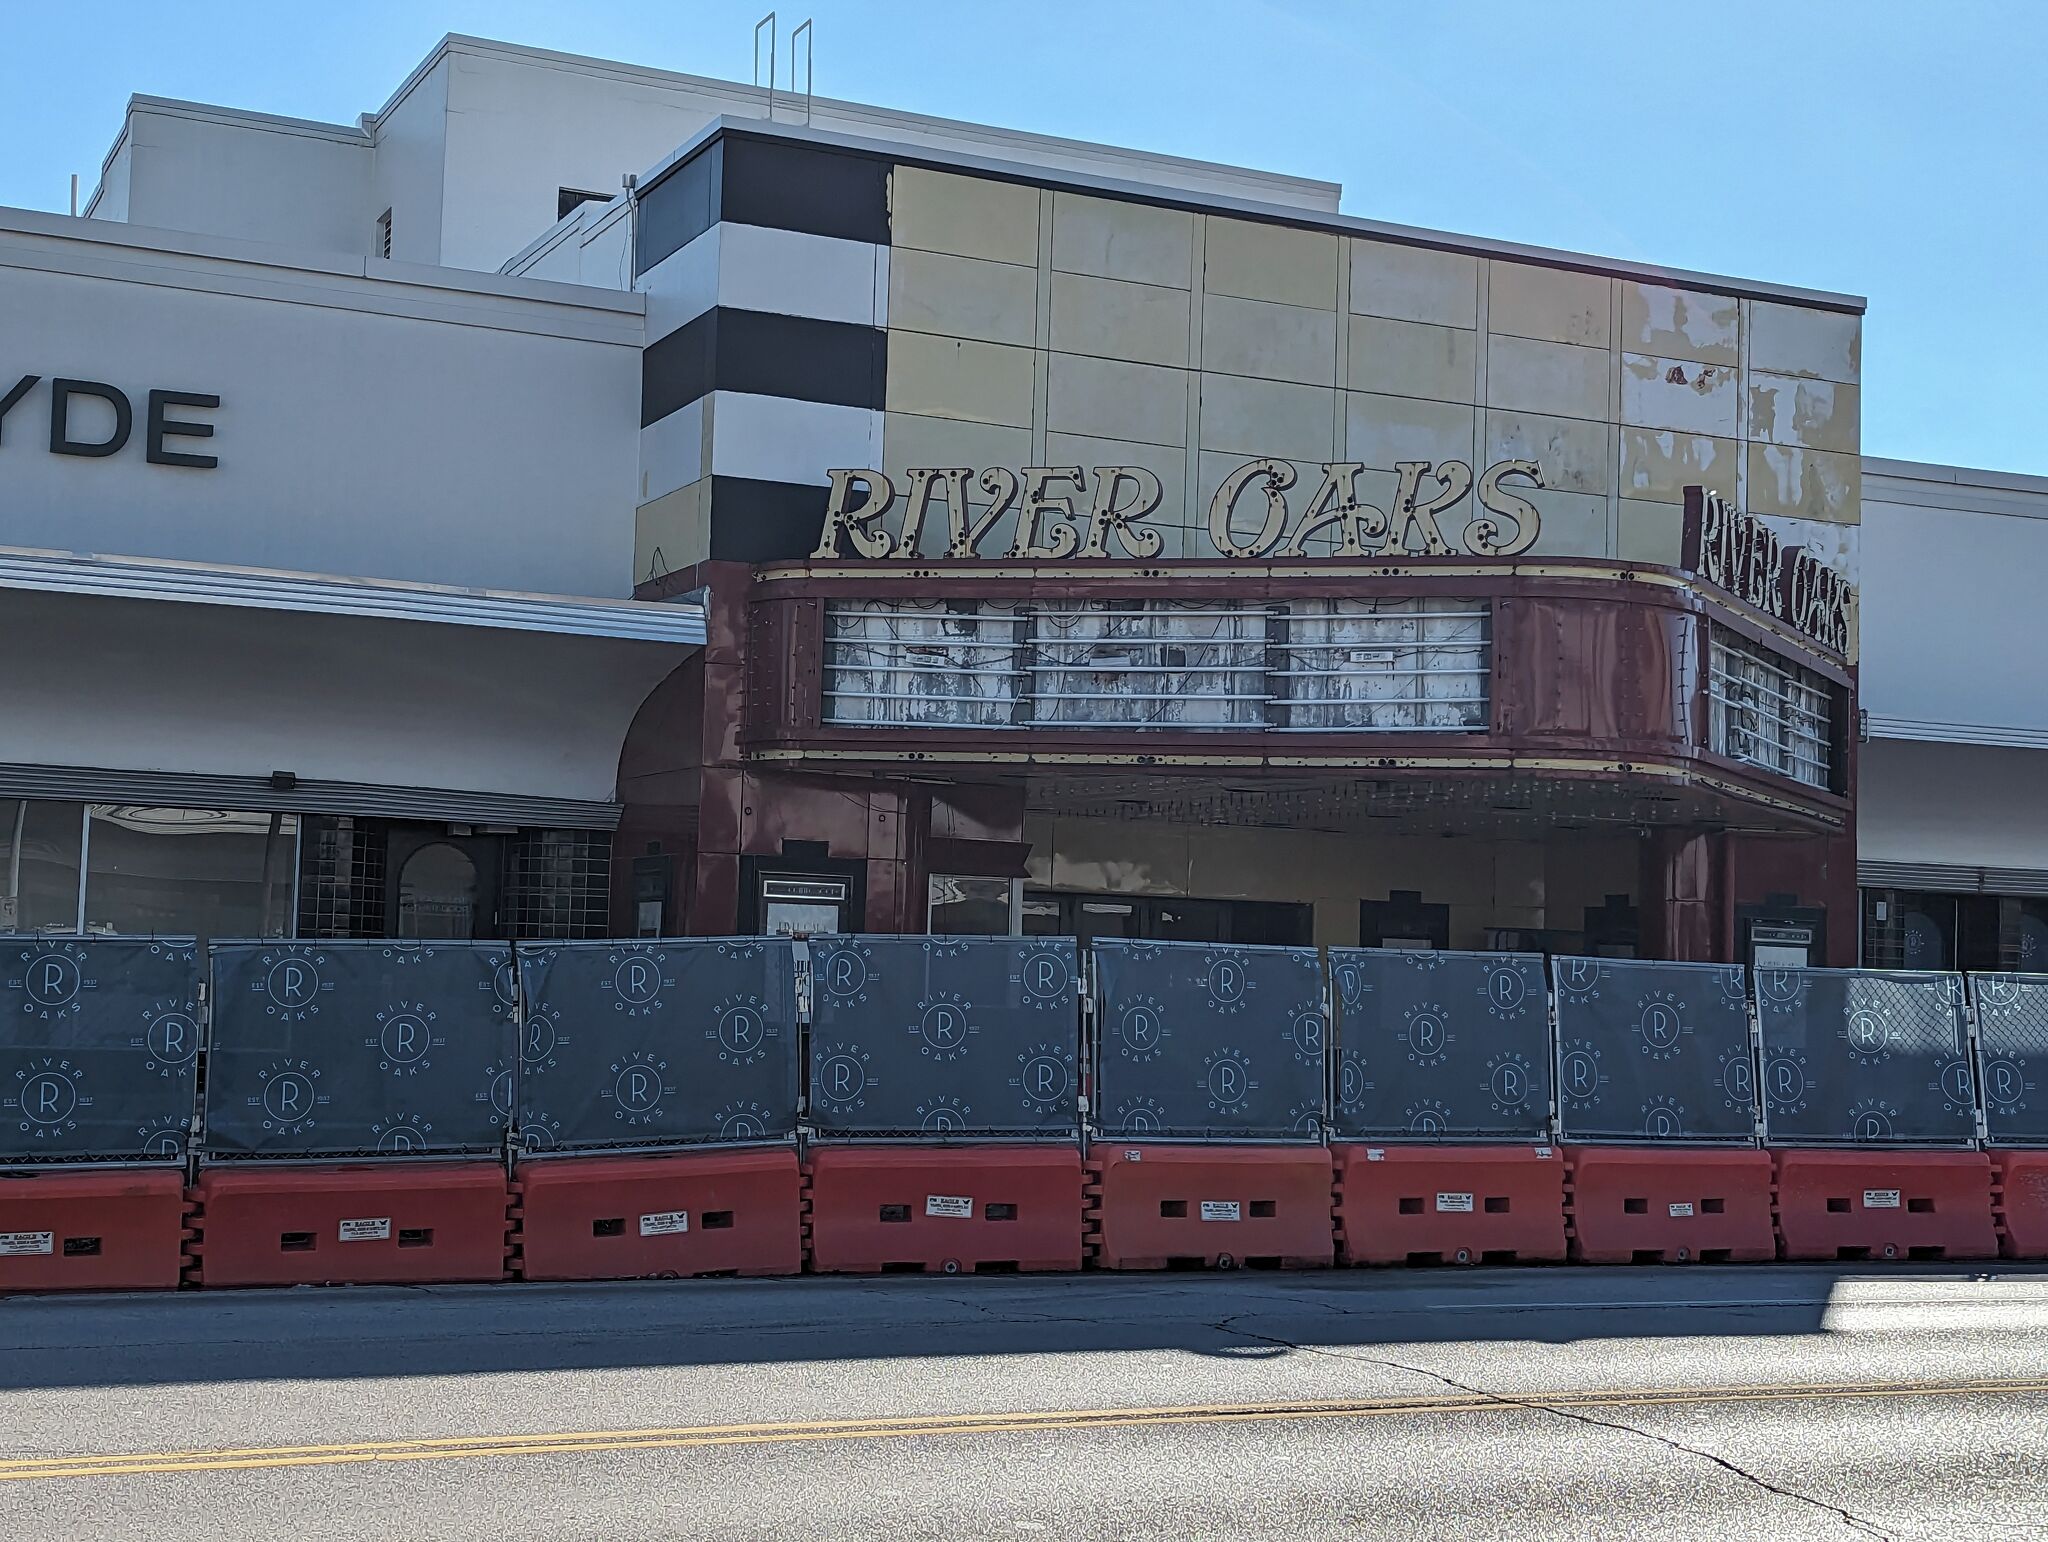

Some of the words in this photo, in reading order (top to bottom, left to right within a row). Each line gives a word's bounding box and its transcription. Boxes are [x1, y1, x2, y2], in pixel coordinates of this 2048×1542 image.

[809, 465, 1165, 559] RIVER
[1207, 459, 1546, 558] OAKS
[1697, 486, 1784, 618] RIVER
[1791, 547, 1852, 657] OAKS
[21, 941, 87, 962] RIVER
[151, 945, 197, 961] OAK
[262, 944, 325, 966] RIVER
[383, 948, 434, 964] OAKS
[609, 944, 666, 964] RIVER
[718, 943, 764, 959] OAKS
[818, 939, 872, 959] RIVER
[922, 942, 969, 958] OAKS
[1018, 941, 1072, 959] RIVER
[1123, 947, 1162, 961] OAKS
[1204, 947, 1250, 967] RIVER
[837, 958, 852, 986] R
[1406, 957, 1446, 970] OAKS
[1483, 956, 1528, 974] RIVER
[44, 963, 63, 994] R
[285, 967, 303, 997] R
[631, 965, 647, 994] R
[1038, 961, 1054, 989] R
[1221, 966, 1234, 993] R
[1343, 970, 1355, 995] R
[1500, 975, 1512, 1000] R
[1559, 989, 1600, 1004] OAKS
[615, 1000, 662, 1016] OAKS
[713, 994, 769, 1014] RIVER
[822, 993, 867, 1008] OAKS
[917, 991, 972, 1010] RIVER
[1022, 995, 1069, 1010] OAKS
[1118, 993, 1165, 1013] RIVER
[1208, 1001, 1246, 1014] OAKS
[1638, 990, 1686, 1010] RIVER
[1761, 1000, 1802, 1013] OAKS
[1843, 998, 1891, 1017] RIVER
[1979, 1002, 2022, 1017] OAKS
[24, 1003, 81, 1019] OAKS
[266, 1004, 319, 1021] OAKS
[376, 1001, 436, 1021] RIVER
[1403, 1001, 1449, 1020] RIVER
[1488, 1007, 1526, 1020] OAKS
[734, 1015, 749, 1043] R
[938, 1011, 953, 1039] R
[1135, 1014, 1148, 1040] R
[1305, 1020, 1319, 1047] R
[1420, 1020, 1433, 1046] R
[1653, 1011, 1667, 1038] R
[1861, 1017, 1876, 1044] R
[165, 1022, 183, 1052] R
[398, 1023, 414, 1053] R
[528, 1023, 541, 1052] R
[719, 1049, 766, 1066] OAKS
[816, 1042, 870, 1061] RIVER
[921, 1046, 968, 1061] OAKS
[1017, 1043, 1073, 1062] RIVER
[1121, 1048, 1162, 1063] OAKS
[1204, 1047, 1250, 1066] RIVER
[1560, 1039, 1601, 1060] IVER
[1641, 1045, 1681, 1060] OAKS
[1848, 1051, 1890, 1065] OAKS
[16, 1058, 82, 1080] RIVER
[258, 1059, 320, 1079] RIVER
[379, 1060, 430, 1076] OAKS
[610, 1051, 667, 1073] RIVER
[1408, 1053, 1447, 1067] OAKS
[1486, 1051, 1531, 1069] RIVER
[835, 1063, 850, 1091] R
[1038, 1064, 1053, 1092] R
[1221, 1066, 1235, 1093] R
[1344, 1068, 1354, 1094] R
[1504, 1070, 1517, 1096] R
[1574, 1059, 1587, 1088] R
[1735, 1064, 1750, 1092] R
[1778, 1066, 1793, 1093] R
[1956, 1068, 1970, 1095] R
[1996, 1068, 2011, 1095] R
[40, 1082, 59, 1112] R
[281, 1081, 299, 1111] R
[632, 1073, 647, 1102] R
[715, 1100, 771, 1121] RIVER
[821, 1098, 865, 1114] OAKS
[916, 1095, 971, 1115] RIVER
[1022, 1099, 1069, 1114] OAKS
[1117, 1095, 1165, 1115] RIVER
[1208, 1100, 1249, 1115] OAKS
[1405, 1098, 1451, 1116] RIVER
[1491, 1102, 1531, 1116] OAKS
[1561, 1095, 1601, 1110] OAKS
[1640, 1095, 1685, 1114] RIVER
[1767, 1100, 1807, 1115] OAKS
[1848, 1098, 1897, 1117] RIVER
[1987, 1101, 2027, 1115] OAKS
[263, 1118, 315, 1135] OAKS
[372, 1112, 432, 1133] RIVER
[615, 1108, 663, 1125] OAKS
[19, 1120, 77, 1138] OAKS
